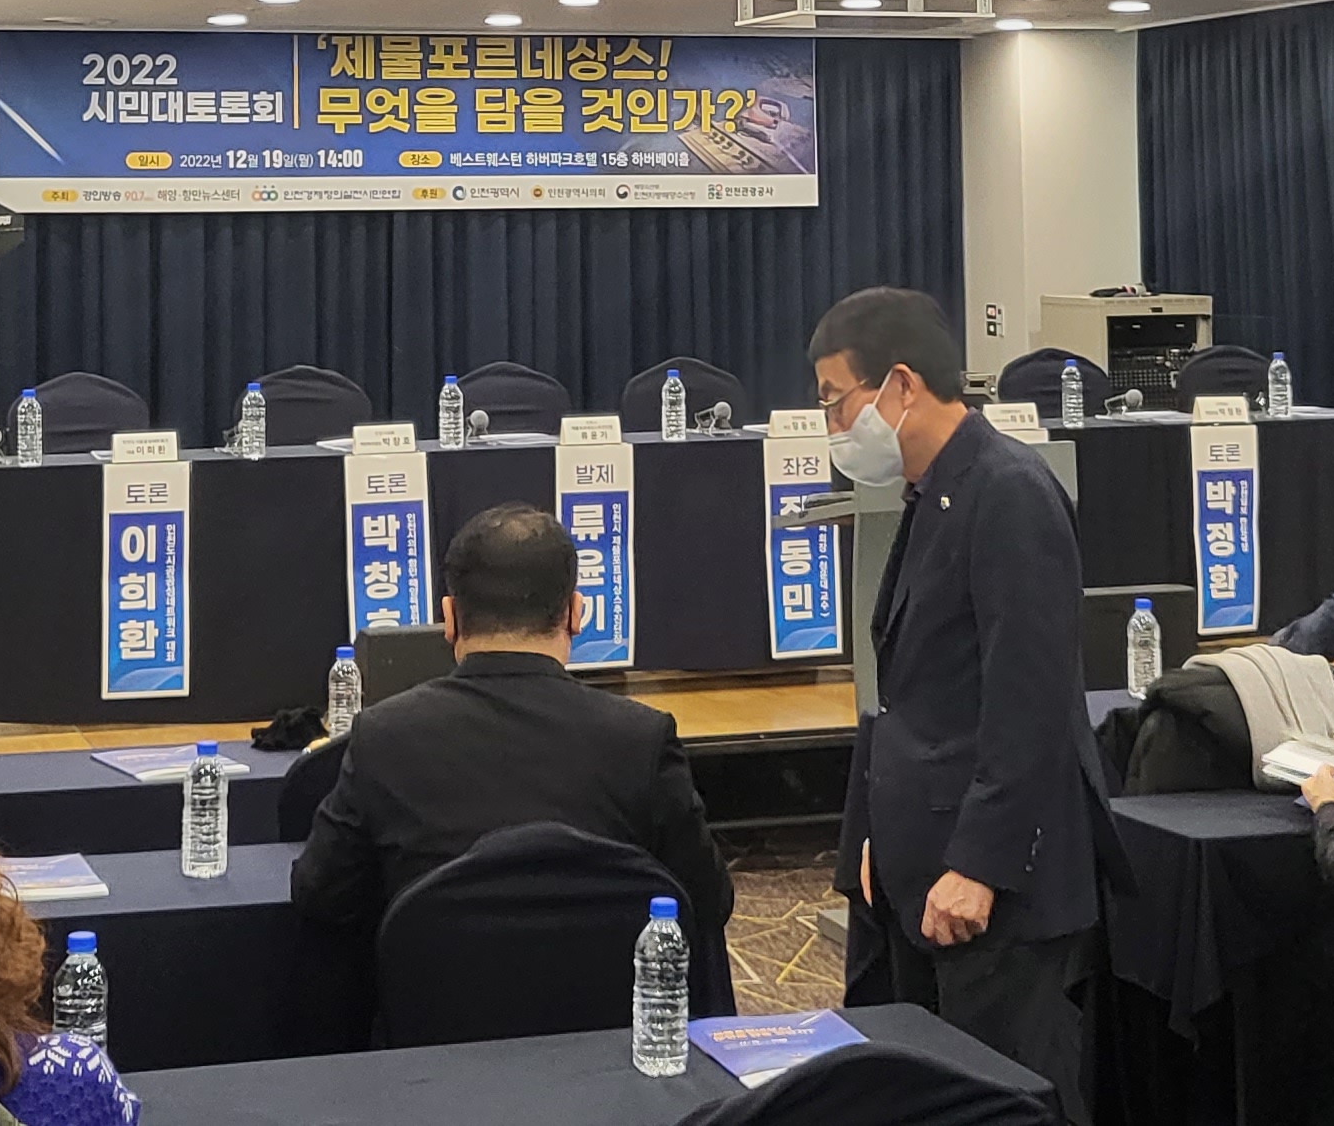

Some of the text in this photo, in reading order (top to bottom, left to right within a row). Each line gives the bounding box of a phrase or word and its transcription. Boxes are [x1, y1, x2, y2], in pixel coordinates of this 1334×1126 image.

[317, 34, 672, 81] '제물포르네상스!
[82, 54, 178, 85] 2022
[82, 91, 283, 123] 시민대토론회
[317, 87, 756, 134] 무엇을 담을 것인가?'
[137, 154, 161, 167] 일시
[179, 149, 363, 169] 2022년 12월 19일(월) 14:00
[409, 154, 432, 166] 장소
[449, 152, 690, 167] 베스트웨스턴 하버파크호텔 15층 하버베이홀
[470, 187, 519, 199] 인천광역시
[548, 187, 606, 199] 인천광역시의회
[1209, 443, 1241, 462] 토론
[575, 464, 615, 484] 발제
[782, 456, 820, 477] 좌장
[125, 482, 168, 504] 토론
[367, 473, 407, 494] 토론
[1205, 480, 1239, 600] 박정환
[571, 504, 606, 632] 류윤기
[119, 524, 159, 661] 이희환
